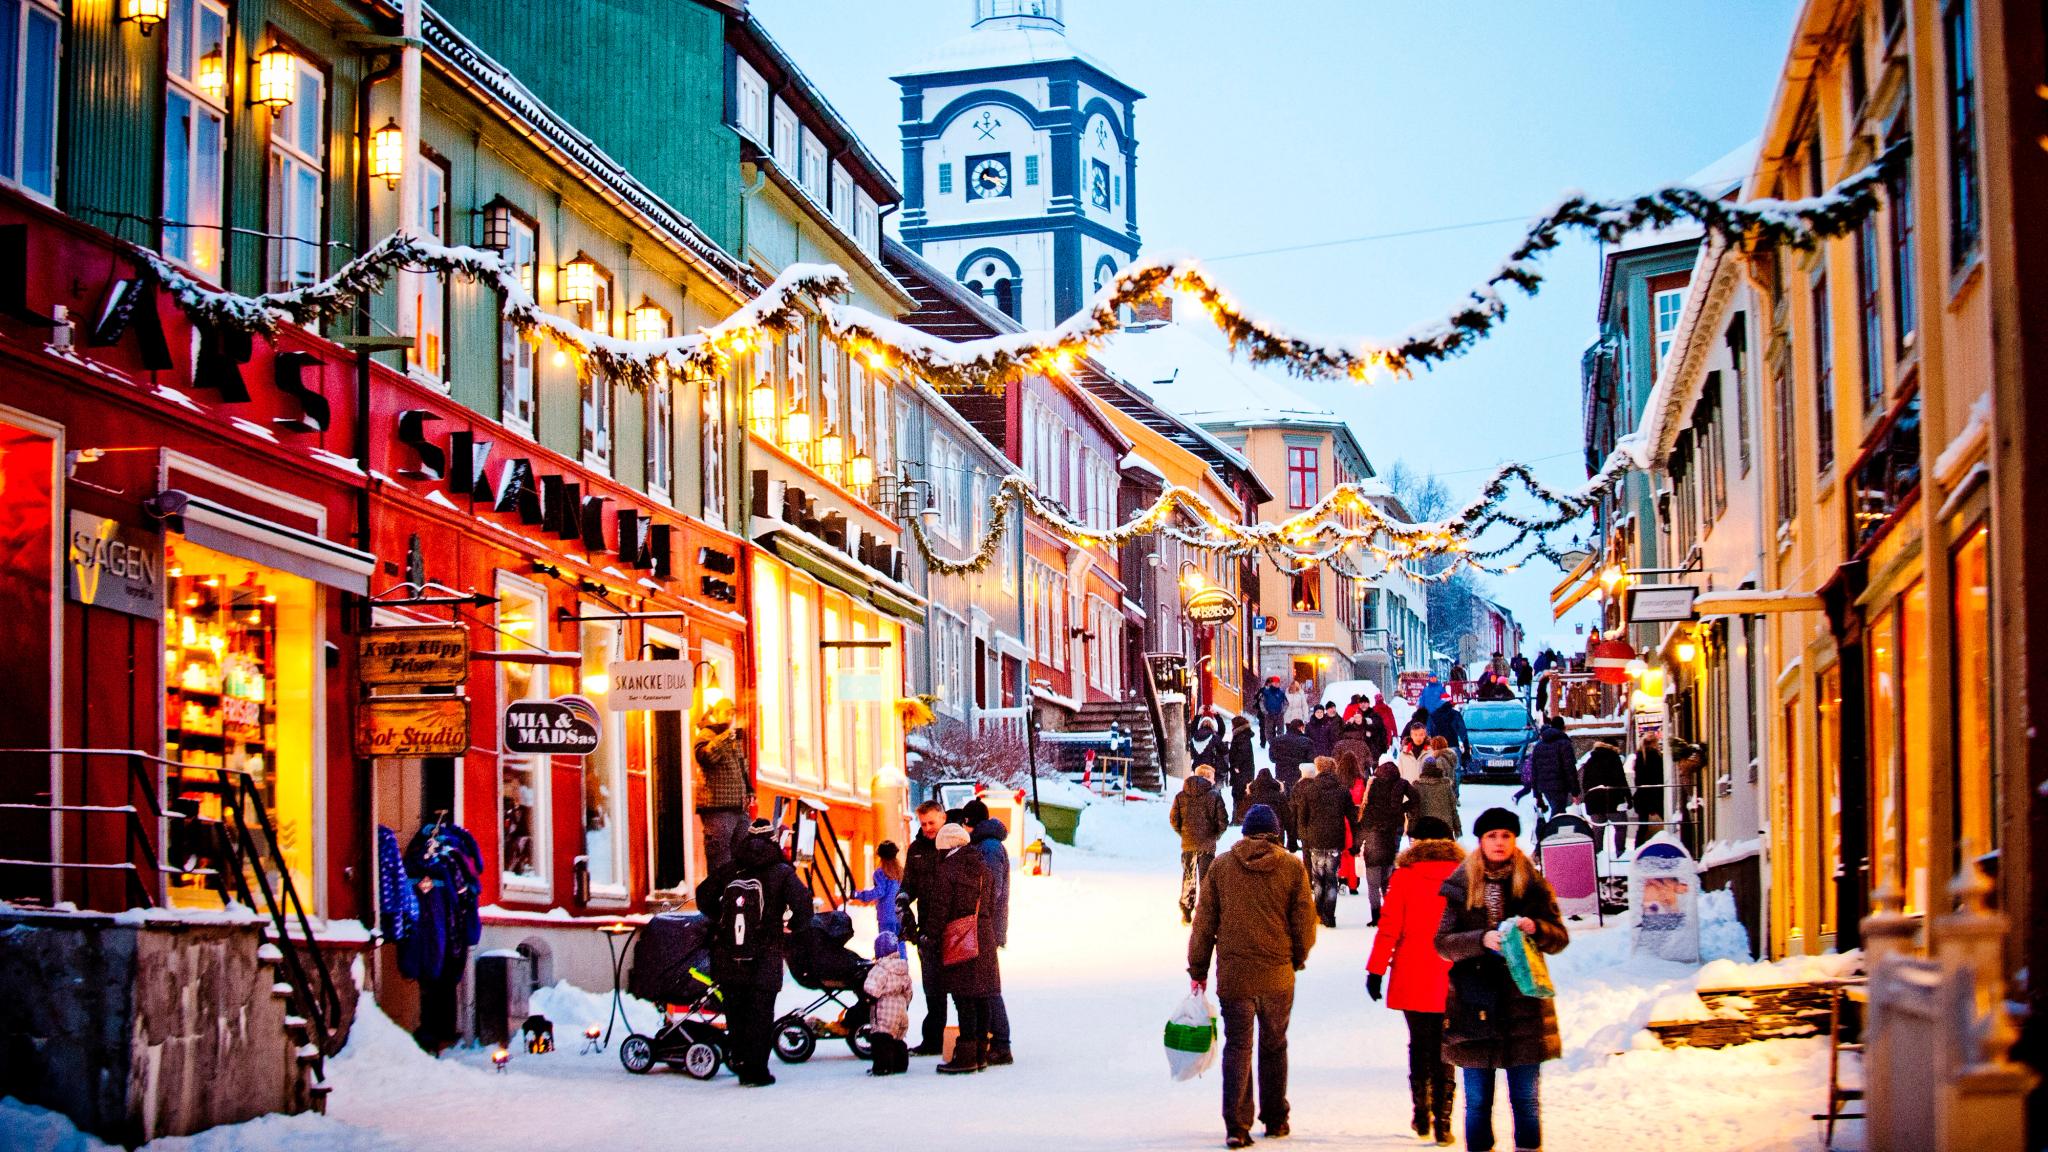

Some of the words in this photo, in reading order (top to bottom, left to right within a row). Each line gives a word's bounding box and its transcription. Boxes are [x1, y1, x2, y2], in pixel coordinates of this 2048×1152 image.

[399, 410, 679, 581] SKANCKE
[1255, 618, 1263, 629] P
[615, 674, 663, 690] SKANCKE
[667, 674, 687, 690] BUA
[508, 712, 551, 728] MIA
[554, 713, 573, 729] &
[518, 728, 597, 745] MADSas
